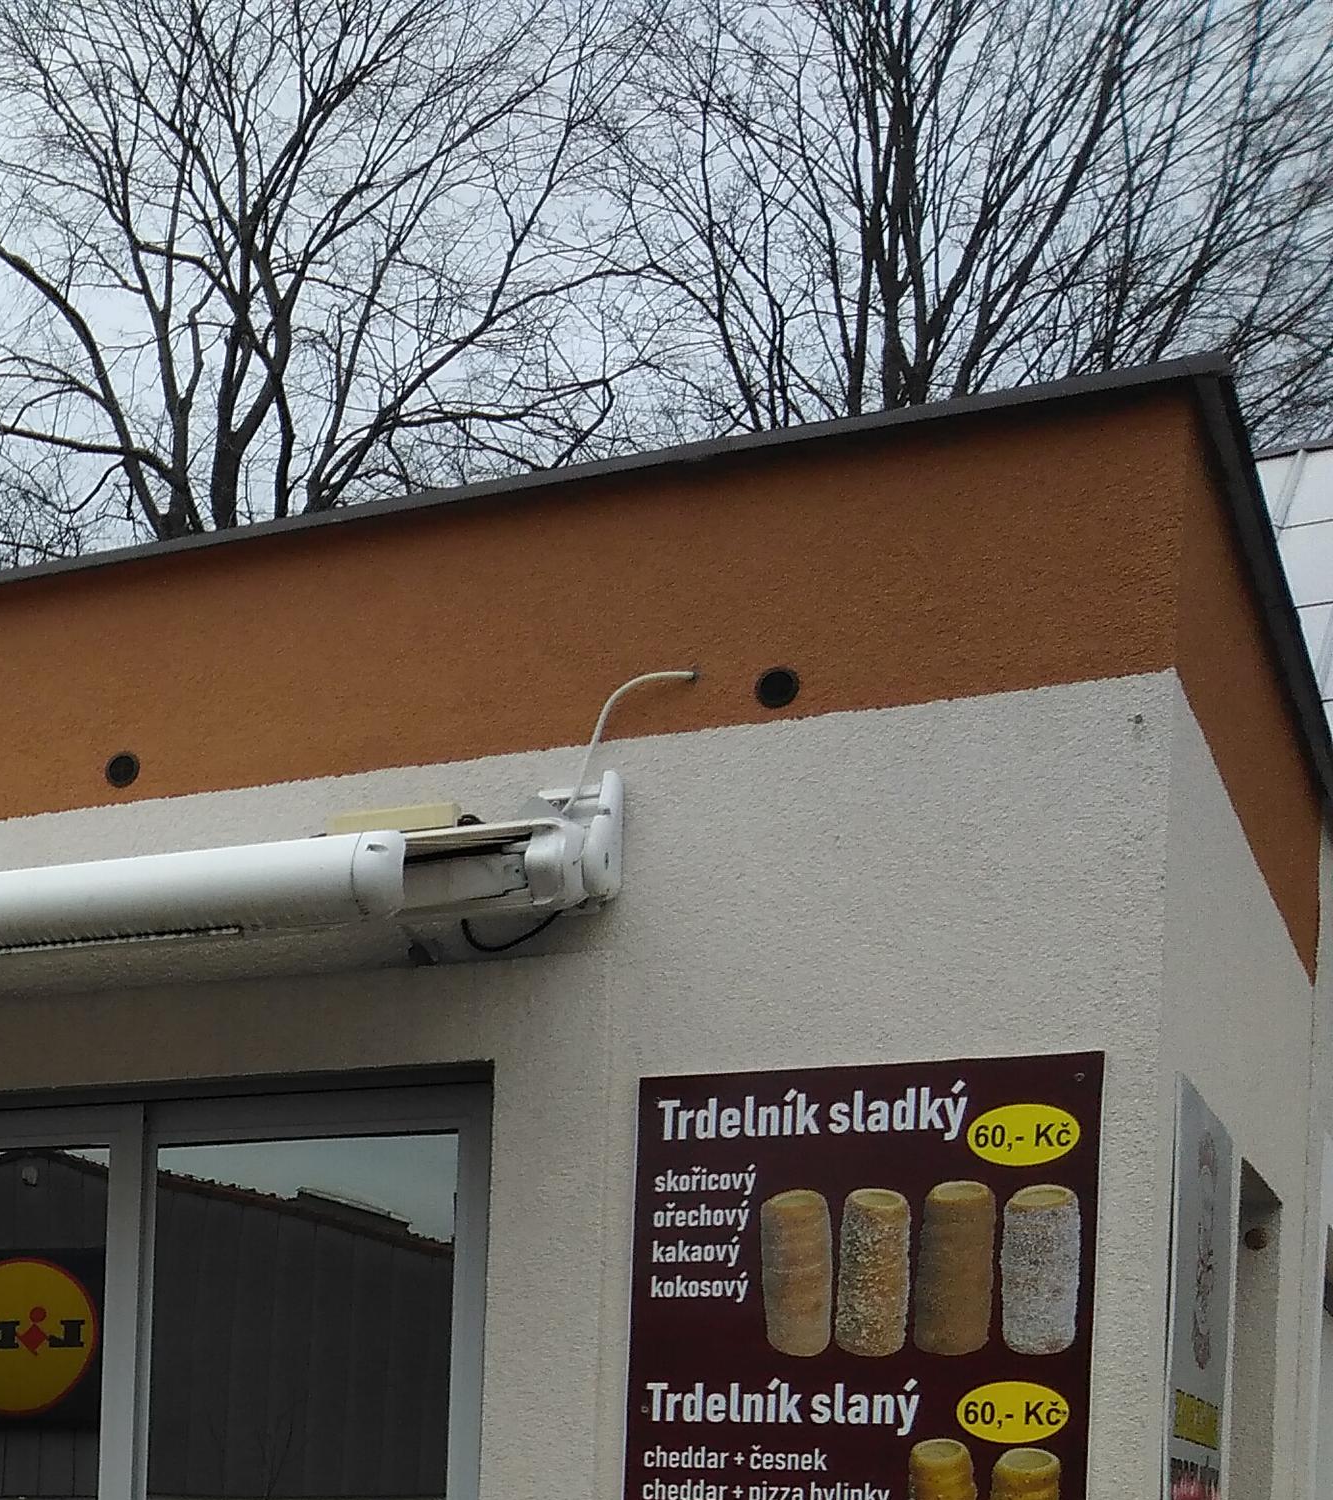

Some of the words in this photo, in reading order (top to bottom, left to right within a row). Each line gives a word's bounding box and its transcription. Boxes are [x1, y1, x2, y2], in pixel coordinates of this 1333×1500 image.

[658, 1089, 820, 1141] Trdelník
[829, 1081, 969, 1141] sladký
[974, 1122, 1025, 1152] 60,-
[1034, 1121, 1073, 1148] Kč
[654, 1165, 757, 1196] skořicový
[653, 1201, 750, 1233] ořechový
[651, 1237, 740, 1268] kakaový
[650, 1271, 750, 1302] kokosový
[646, 1378, 802, 1425] Trdelník
[810, 1378, 920, 1435] slaný
[963, 1401, 1014, 1430] 60,-
[1024, 1401, 1063, 1426] Kč
[643, 1447, 729, 1470] cheddar
[749, 1446, 827, 1472] česnek
